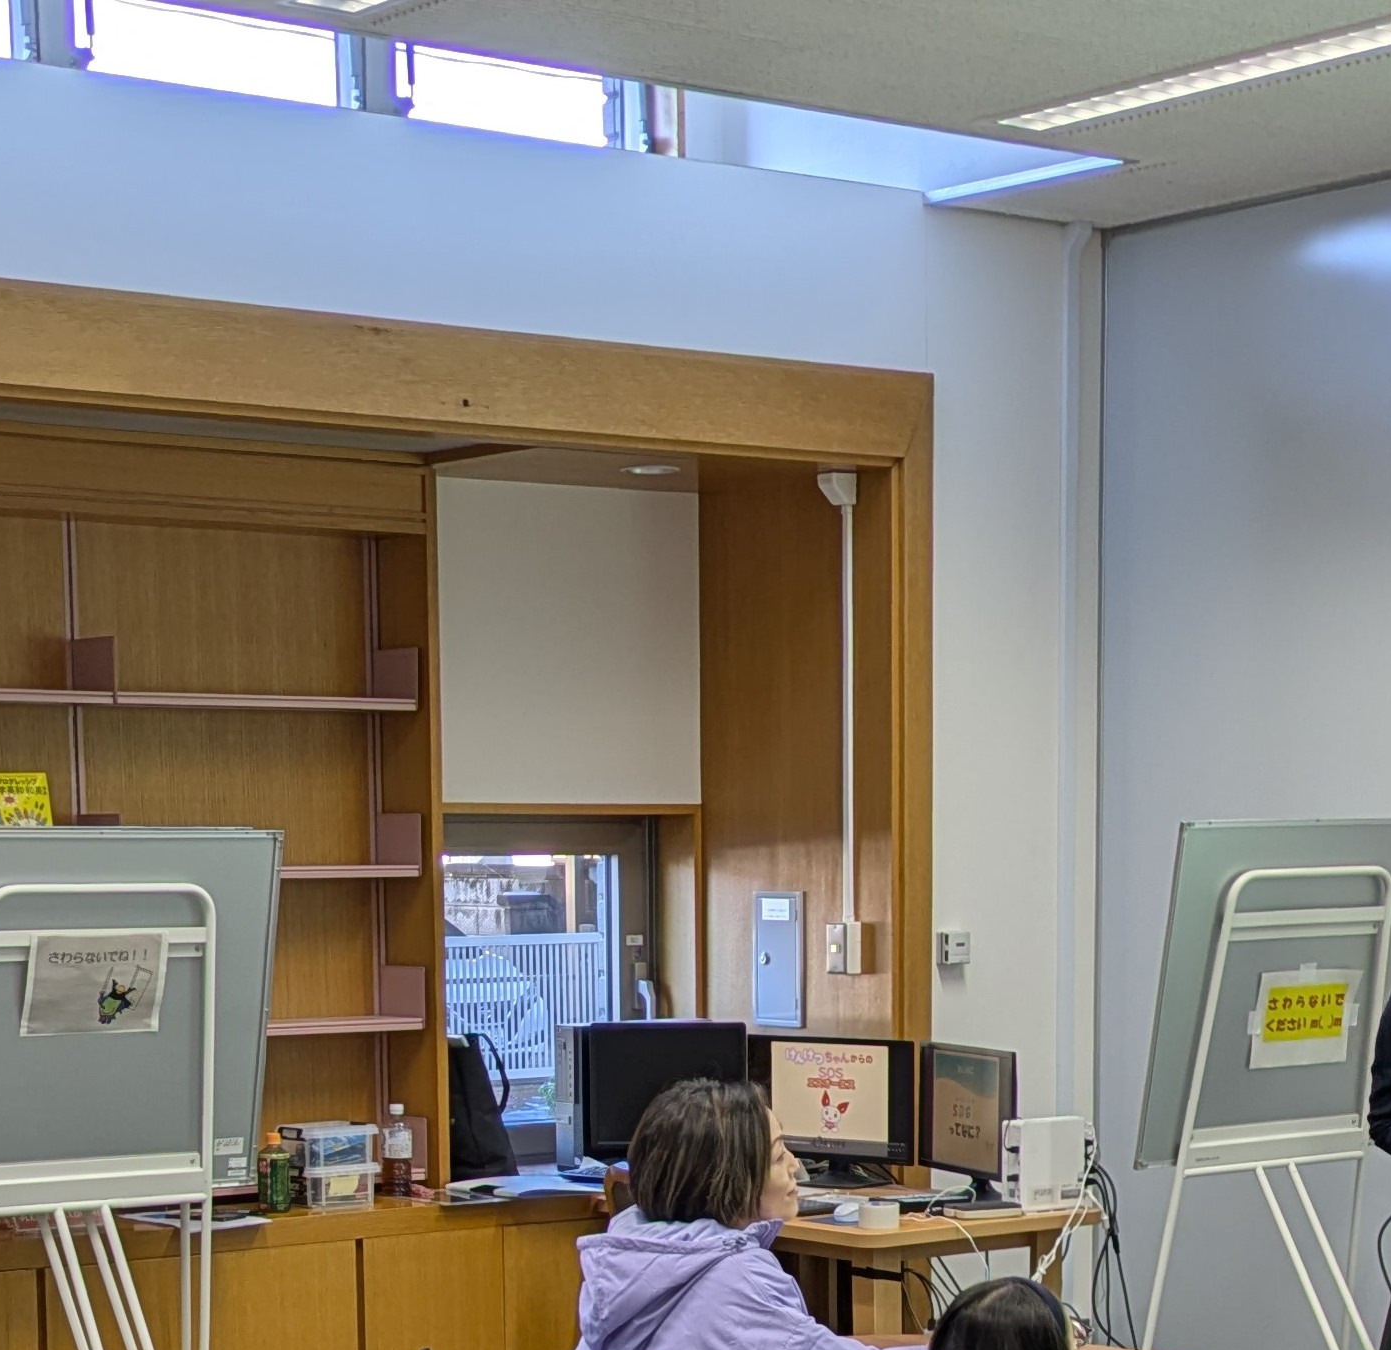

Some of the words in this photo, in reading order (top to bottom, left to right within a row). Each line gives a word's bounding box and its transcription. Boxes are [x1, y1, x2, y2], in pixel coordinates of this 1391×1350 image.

[1267, 993, 1346, 1011] さわらないで
[1265, 1017, 1307, 1032] ください
[818, 1067, 844, 1079] SOS
